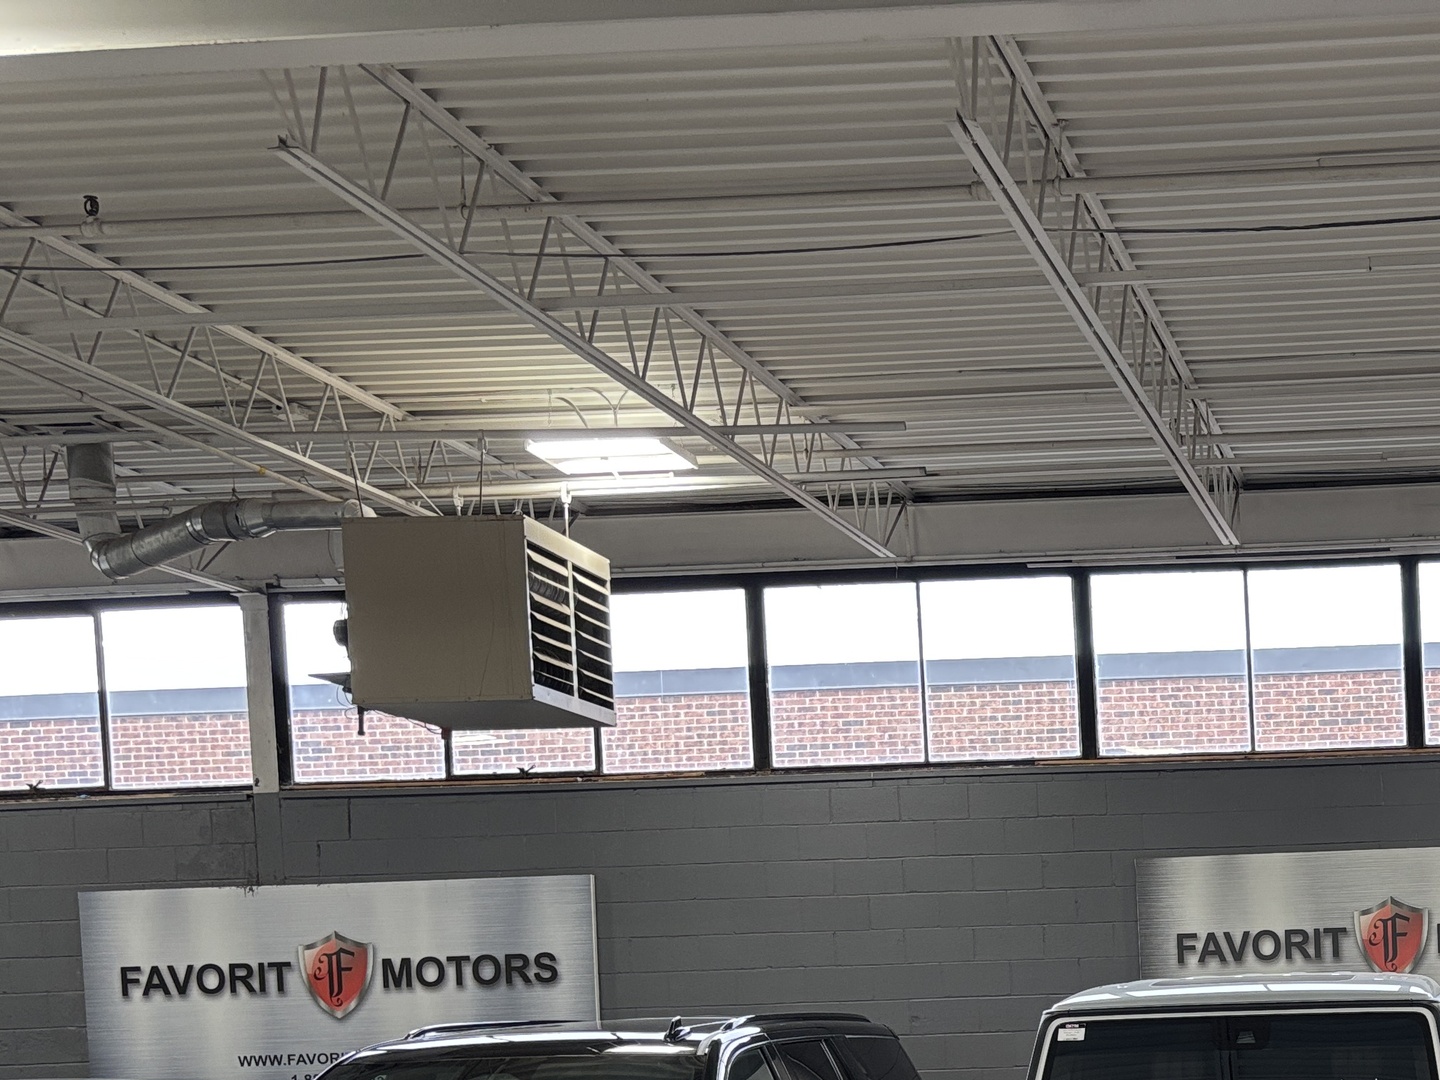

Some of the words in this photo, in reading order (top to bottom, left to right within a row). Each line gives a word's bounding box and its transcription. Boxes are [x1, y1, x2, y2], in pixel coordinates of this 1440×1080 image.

[1176, 927, 1348, 964] FAVORIT
[120, 961, 292, 997] FAVORIT
[381, 952, 559, 989] MOTORS
